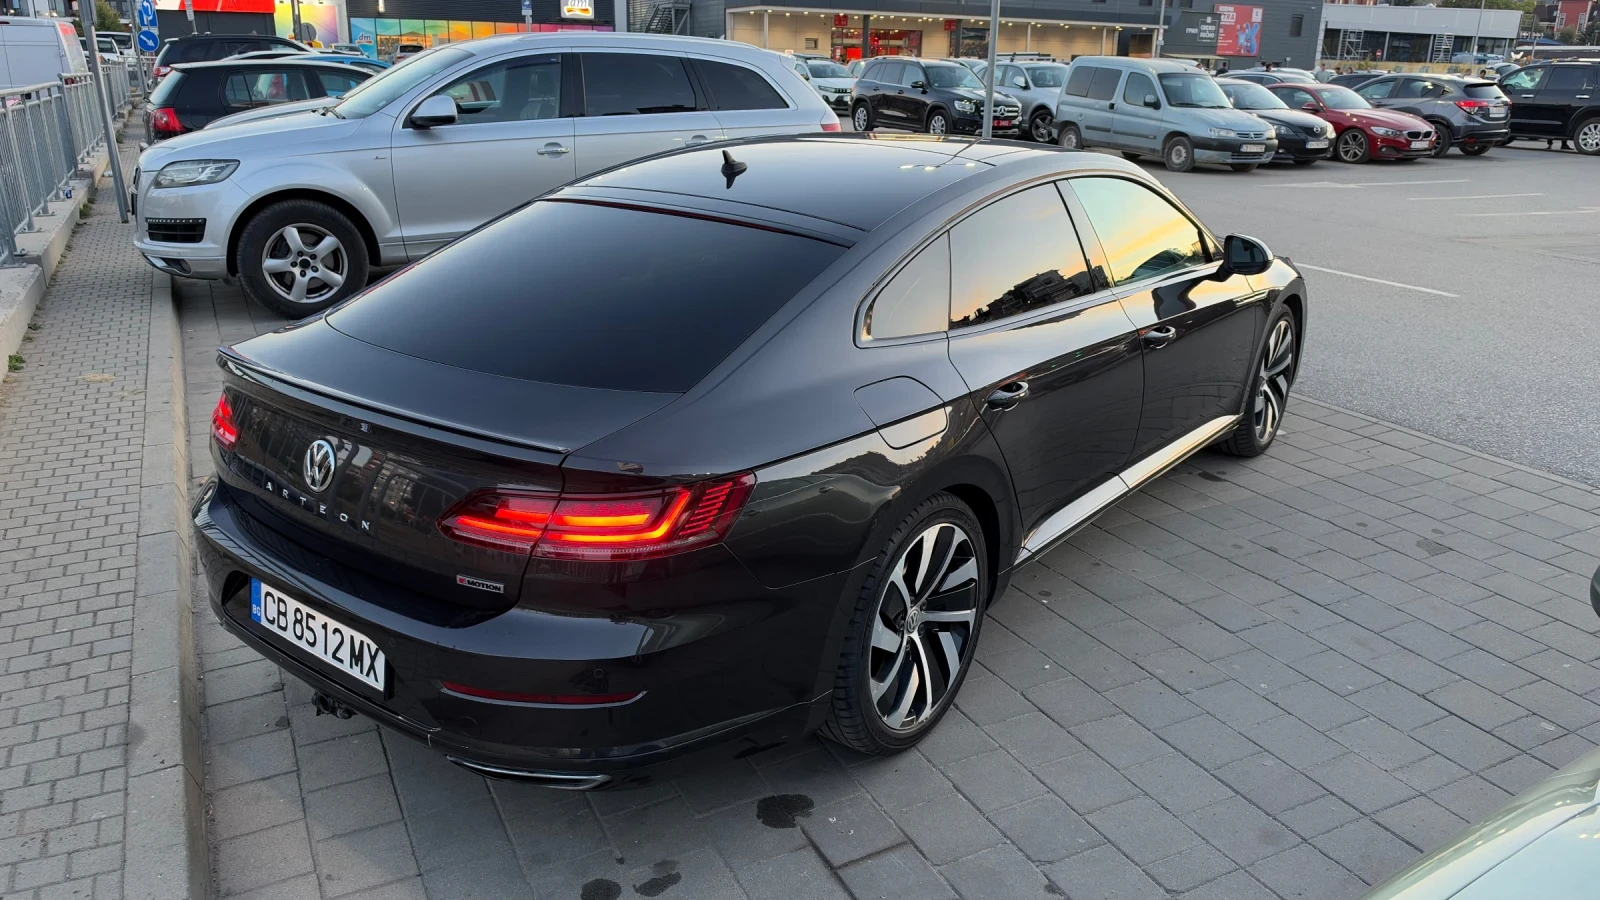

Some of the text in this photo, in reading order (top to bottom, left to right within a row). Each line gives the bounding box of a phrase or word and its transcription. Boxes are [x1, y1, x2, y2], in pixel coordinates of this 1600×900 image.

[265, 481, 370, 531] ARTEON
[252, 603, 261, 617] BG
[263, 590, 380, 683] CB 8512 MX
